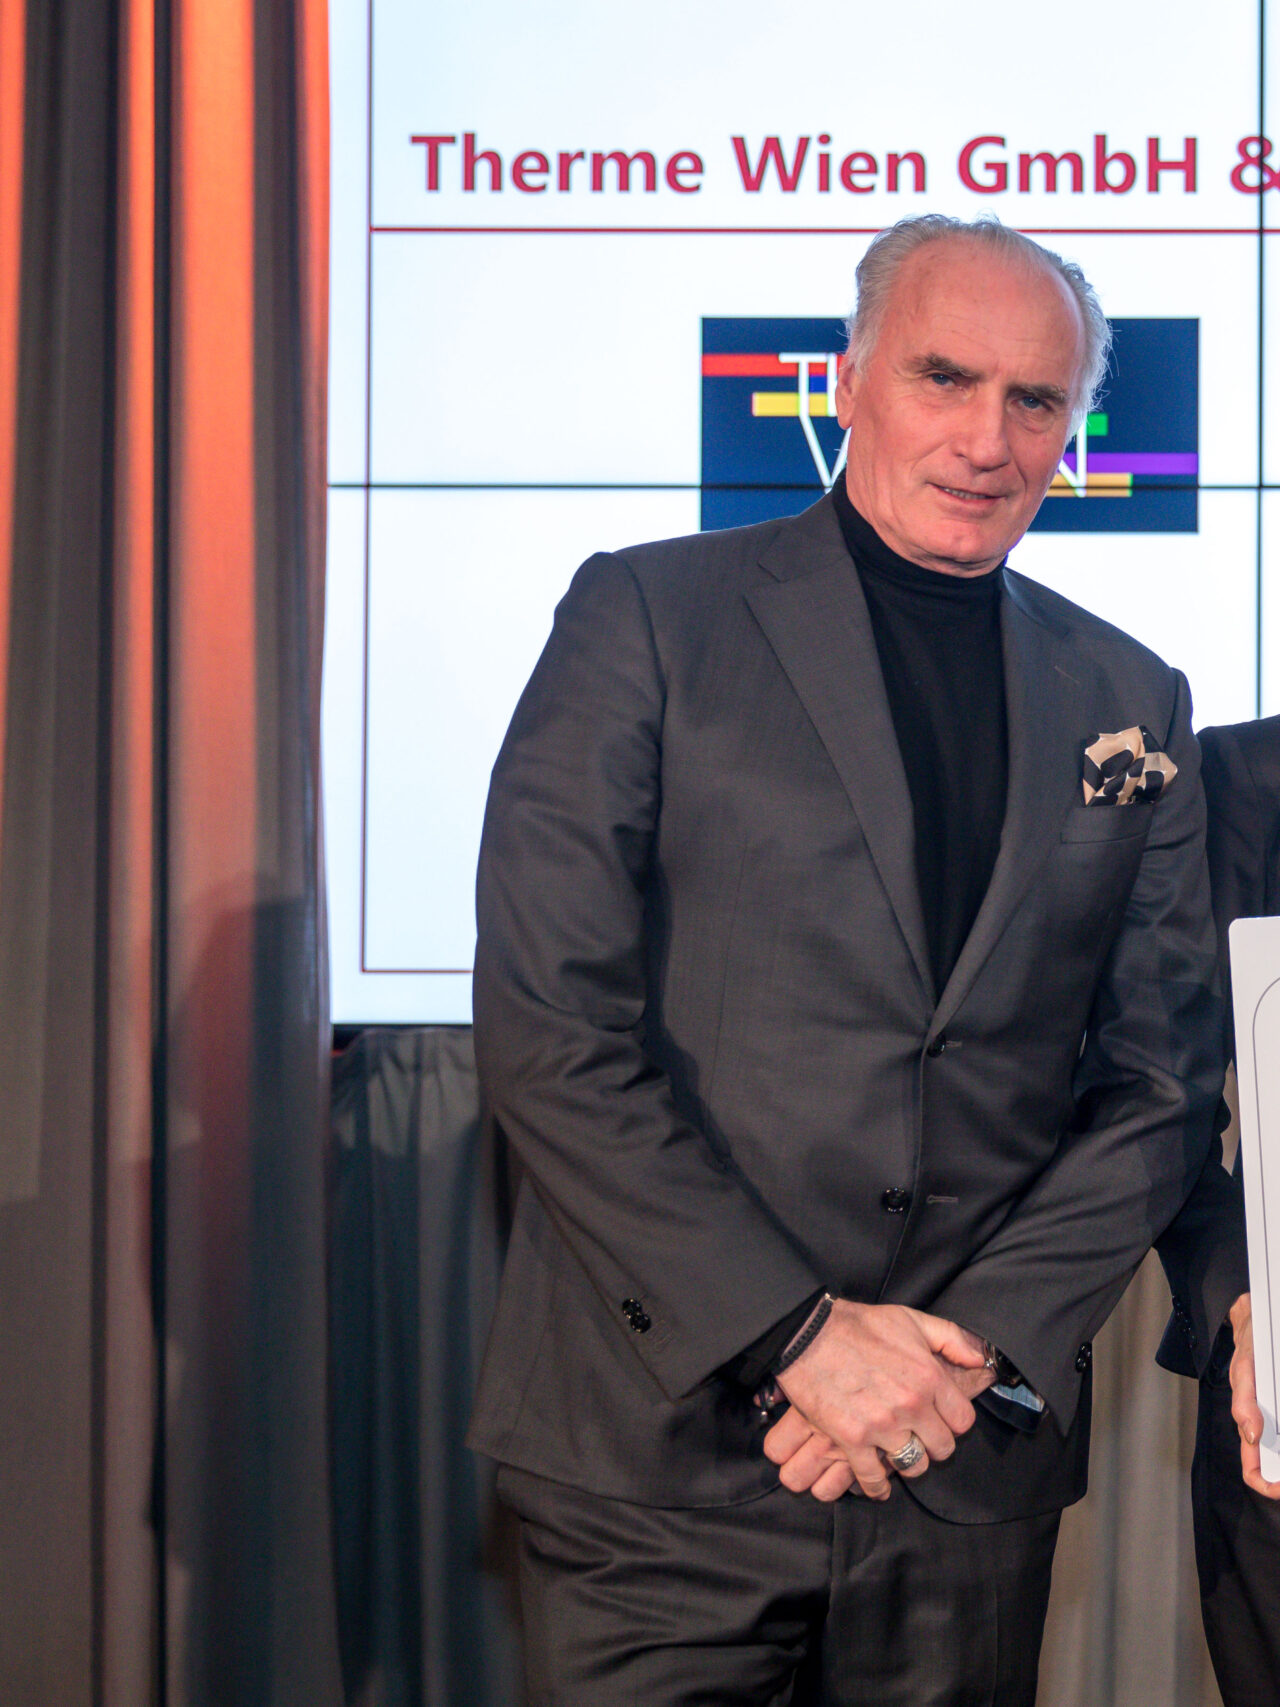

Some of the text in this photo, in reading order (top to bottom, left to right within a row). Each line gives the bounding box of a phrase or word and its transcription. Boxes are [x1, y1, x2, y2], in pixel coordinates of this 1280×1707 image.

[411, 133, 703, 193] Therme
[731, 133, 926, 194] Wien
[957, 134, 1198, 194] GmbH
